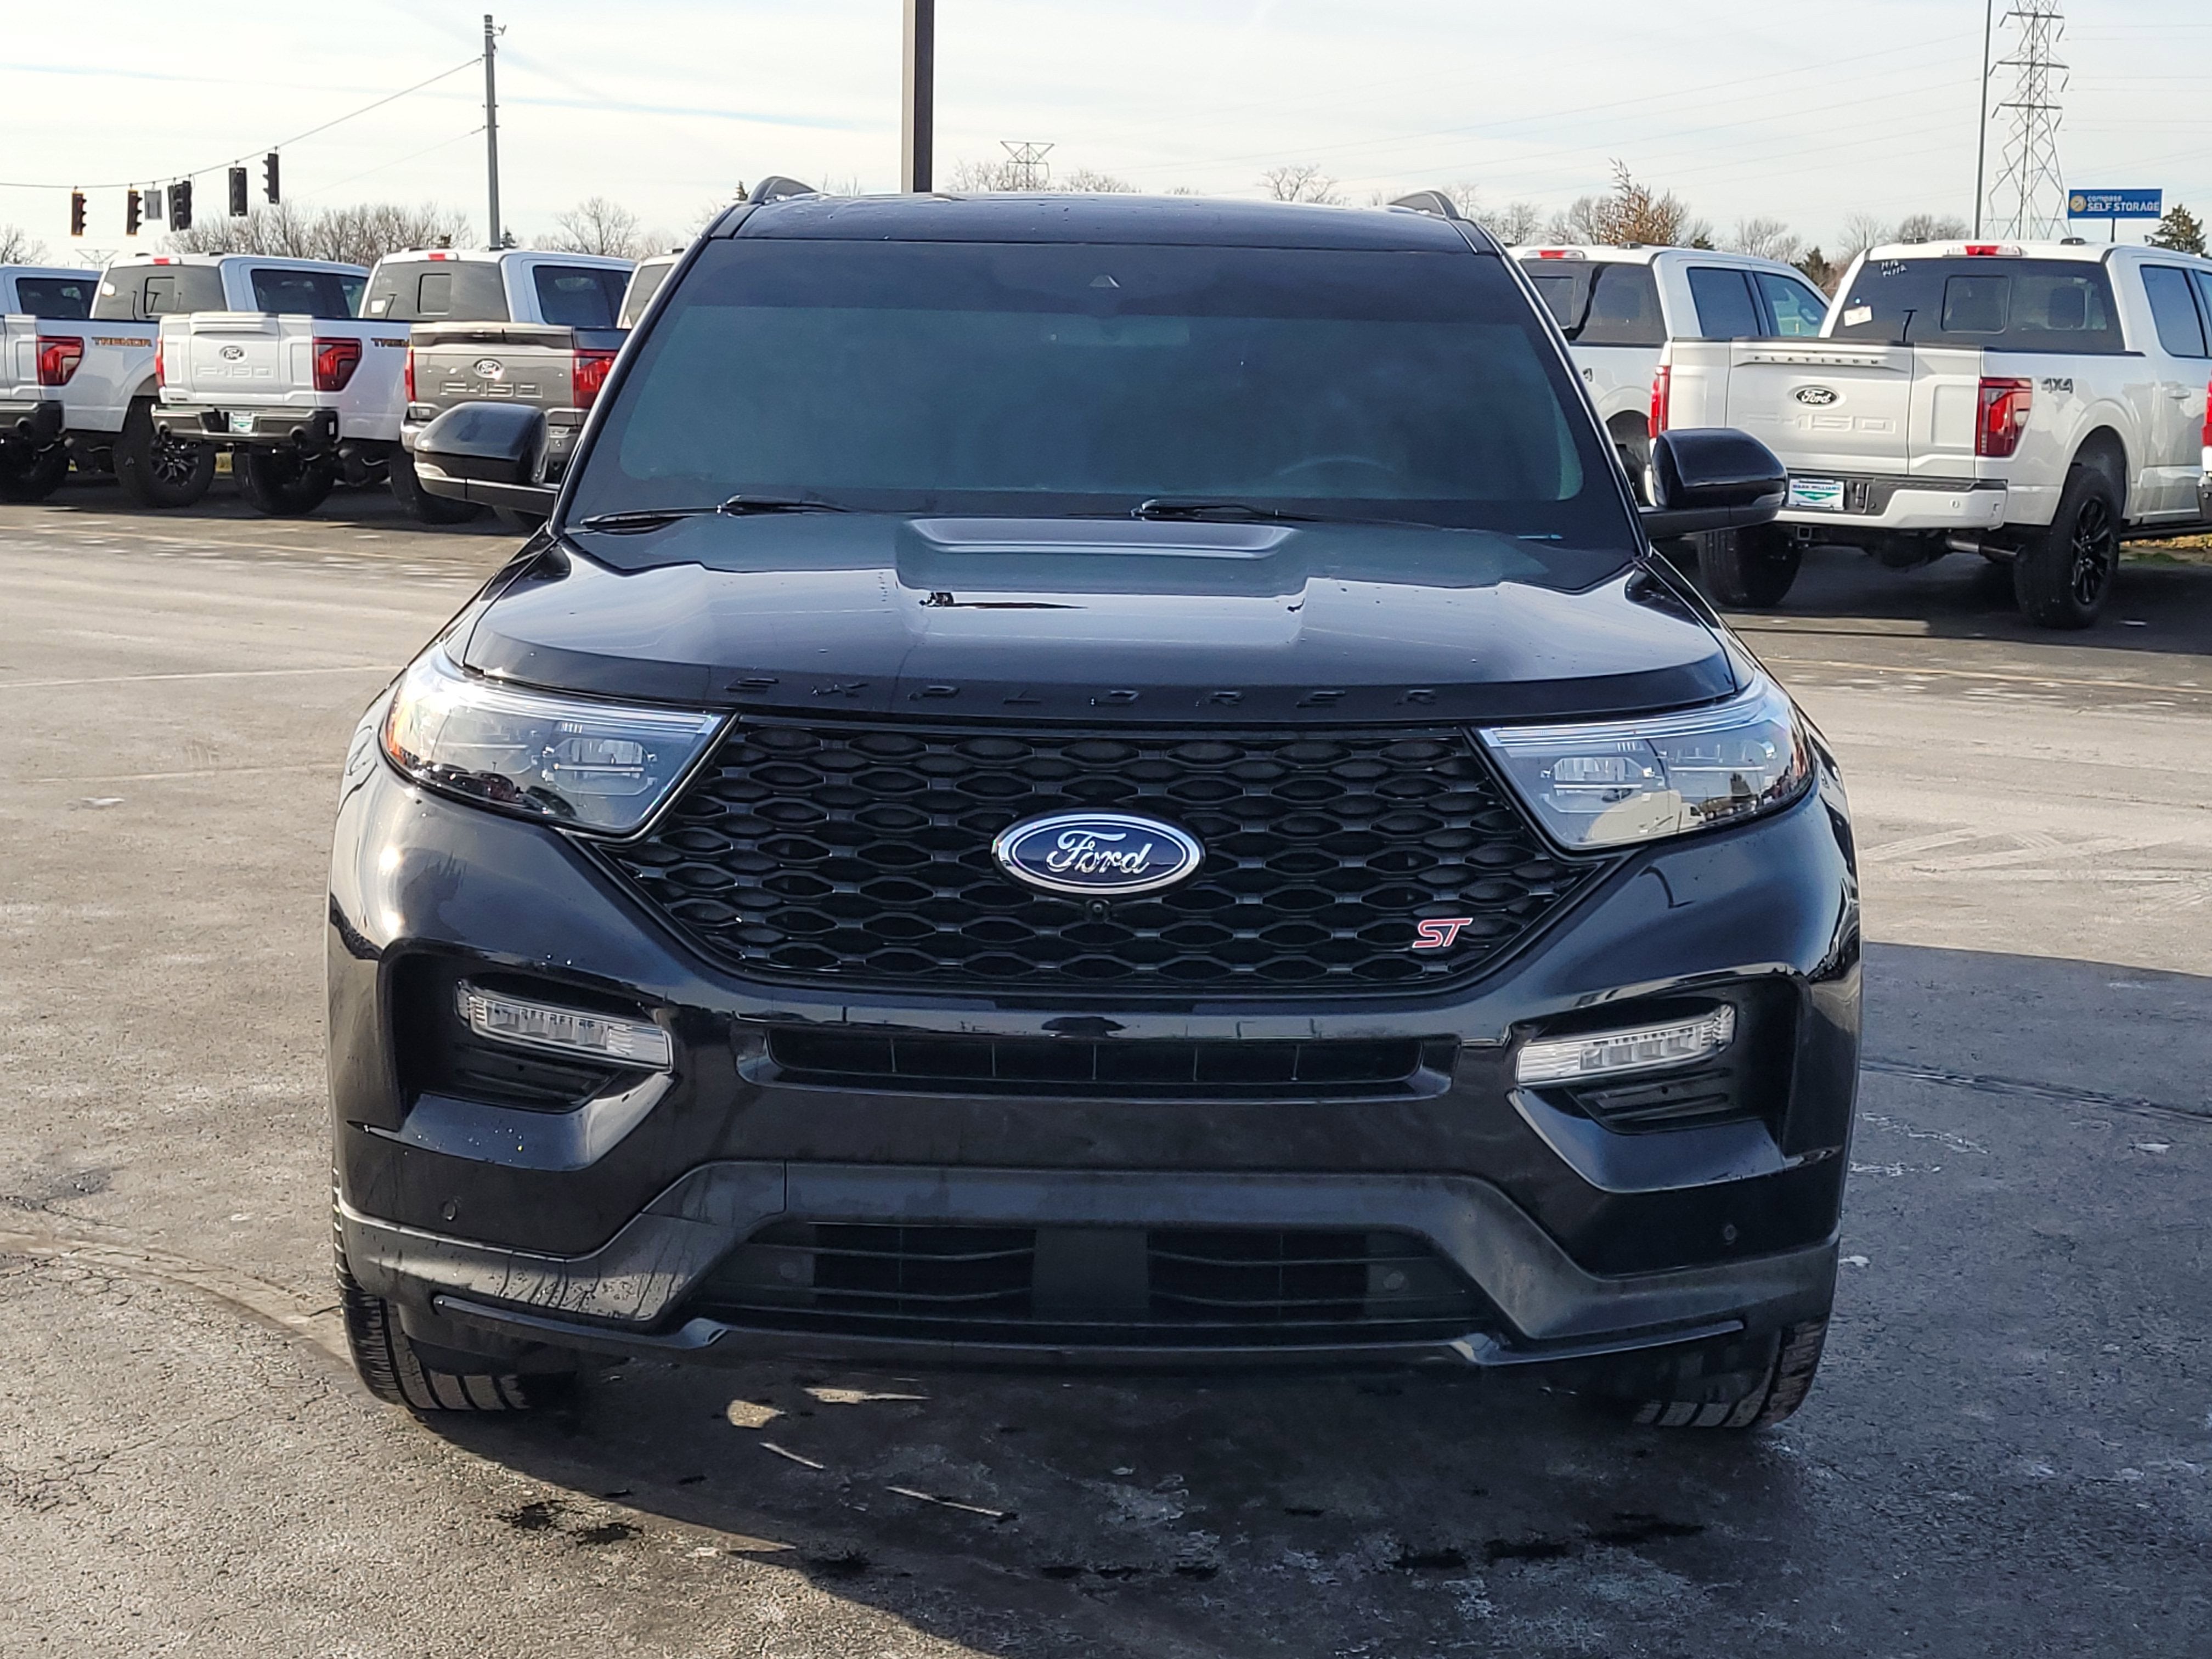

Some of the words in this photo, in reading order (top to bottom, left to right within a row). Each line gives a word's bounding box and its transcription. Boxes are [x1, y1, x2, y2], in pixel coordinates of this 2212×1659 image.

[2087, 202, 2112, 212] SELF
[2113, 201, 2160, 212] STORAGE
[91, 336, 153, 347] TREMOR
[1754, 356, 1878, 364] PLATINUM
[196, 366, 274, 379] F-150
[439, 381, 543, 398] F-150
[1801, 389, 1831, 403] Ford
[1742, 413, 1896, 434] F-150
[724, 676, 1436, 708] EXPLORER
[1046, 830, 1153, 874] Ford
[1412, 917, 1474, 949] ST
